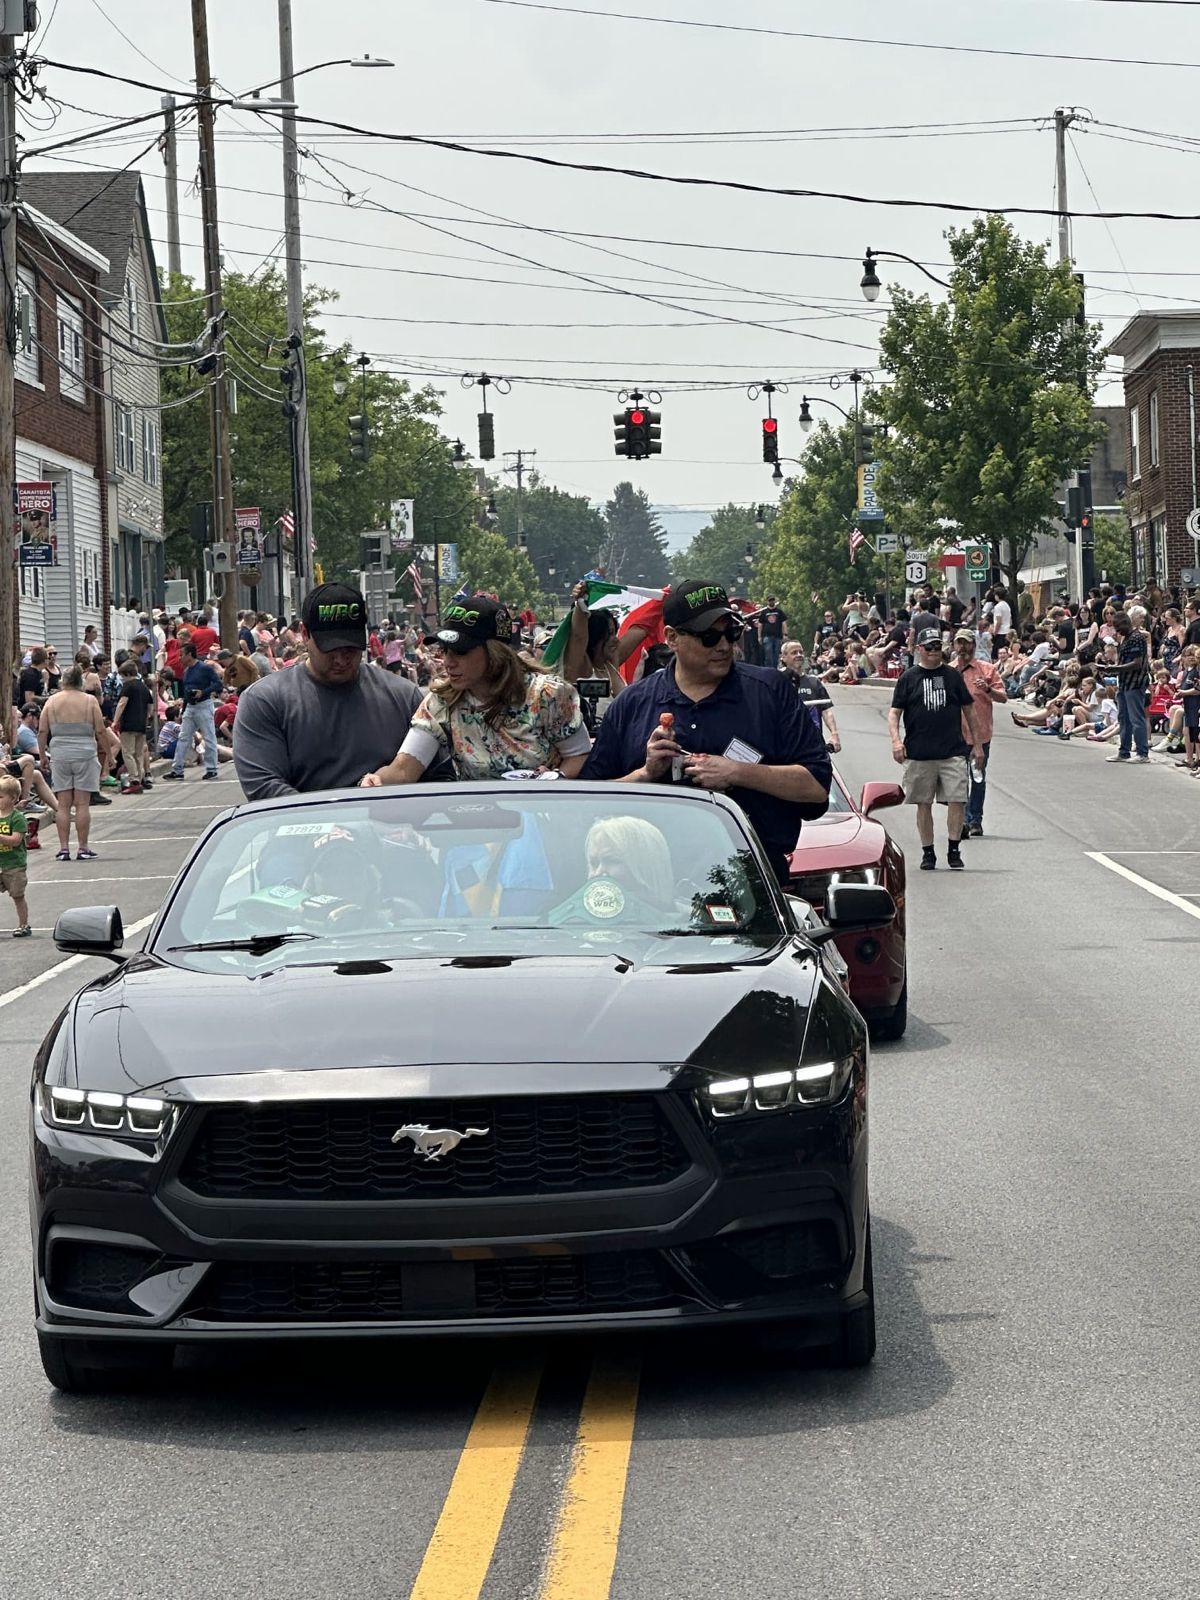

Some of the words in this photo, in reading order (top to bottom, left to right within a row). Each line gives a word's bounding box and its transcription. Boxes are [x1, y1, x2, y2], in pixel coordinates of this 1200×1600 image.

[21, 500, 50, 508] HERO
[879, 537, 888, 550] P
[906, 552, 927, 560] SOUTH
[909, 567, 923, 579] 13
[318, 603, 360, 621] WBC
